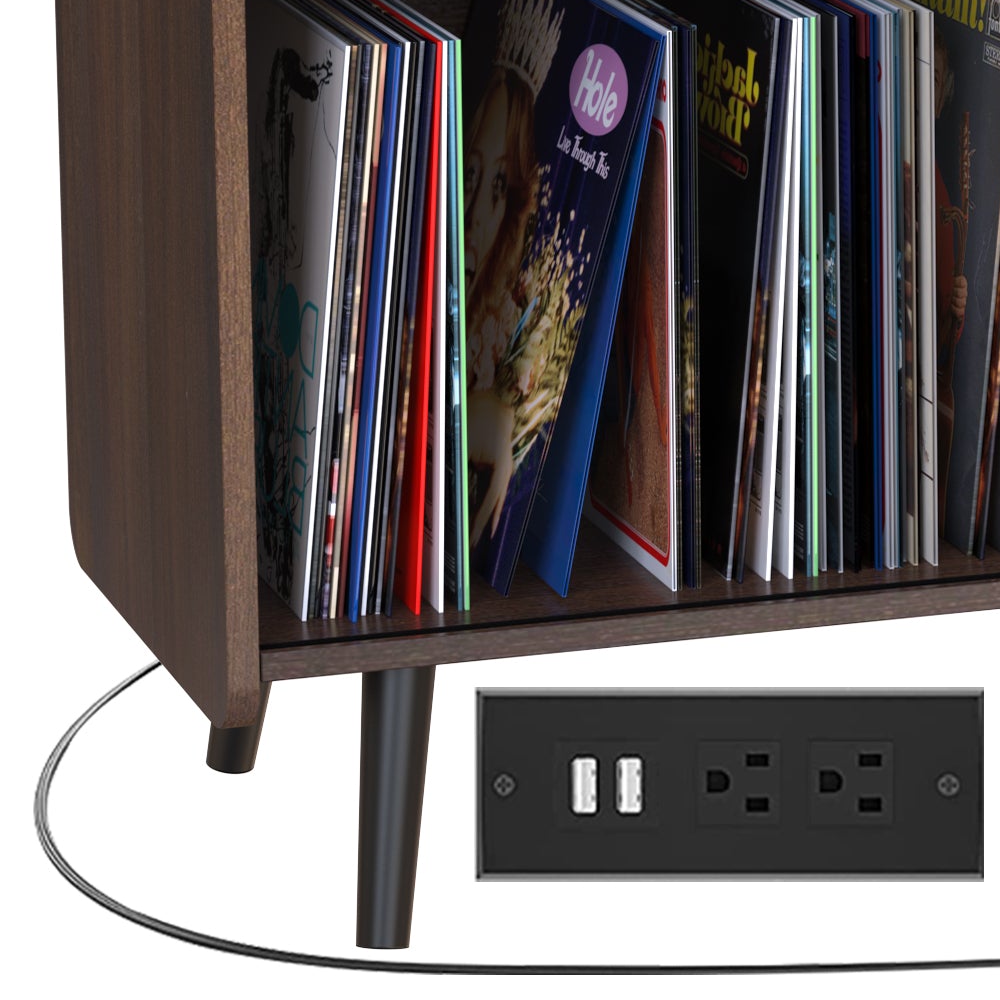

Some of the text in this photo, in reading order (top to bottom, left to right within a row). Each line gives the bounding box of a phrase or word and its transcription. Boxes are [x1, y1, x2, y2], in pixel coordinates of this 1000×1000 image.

[573, 48, 619, 129] Hole
[570, 134, 598, 173] Through
[595, 151, 611, 181] This
